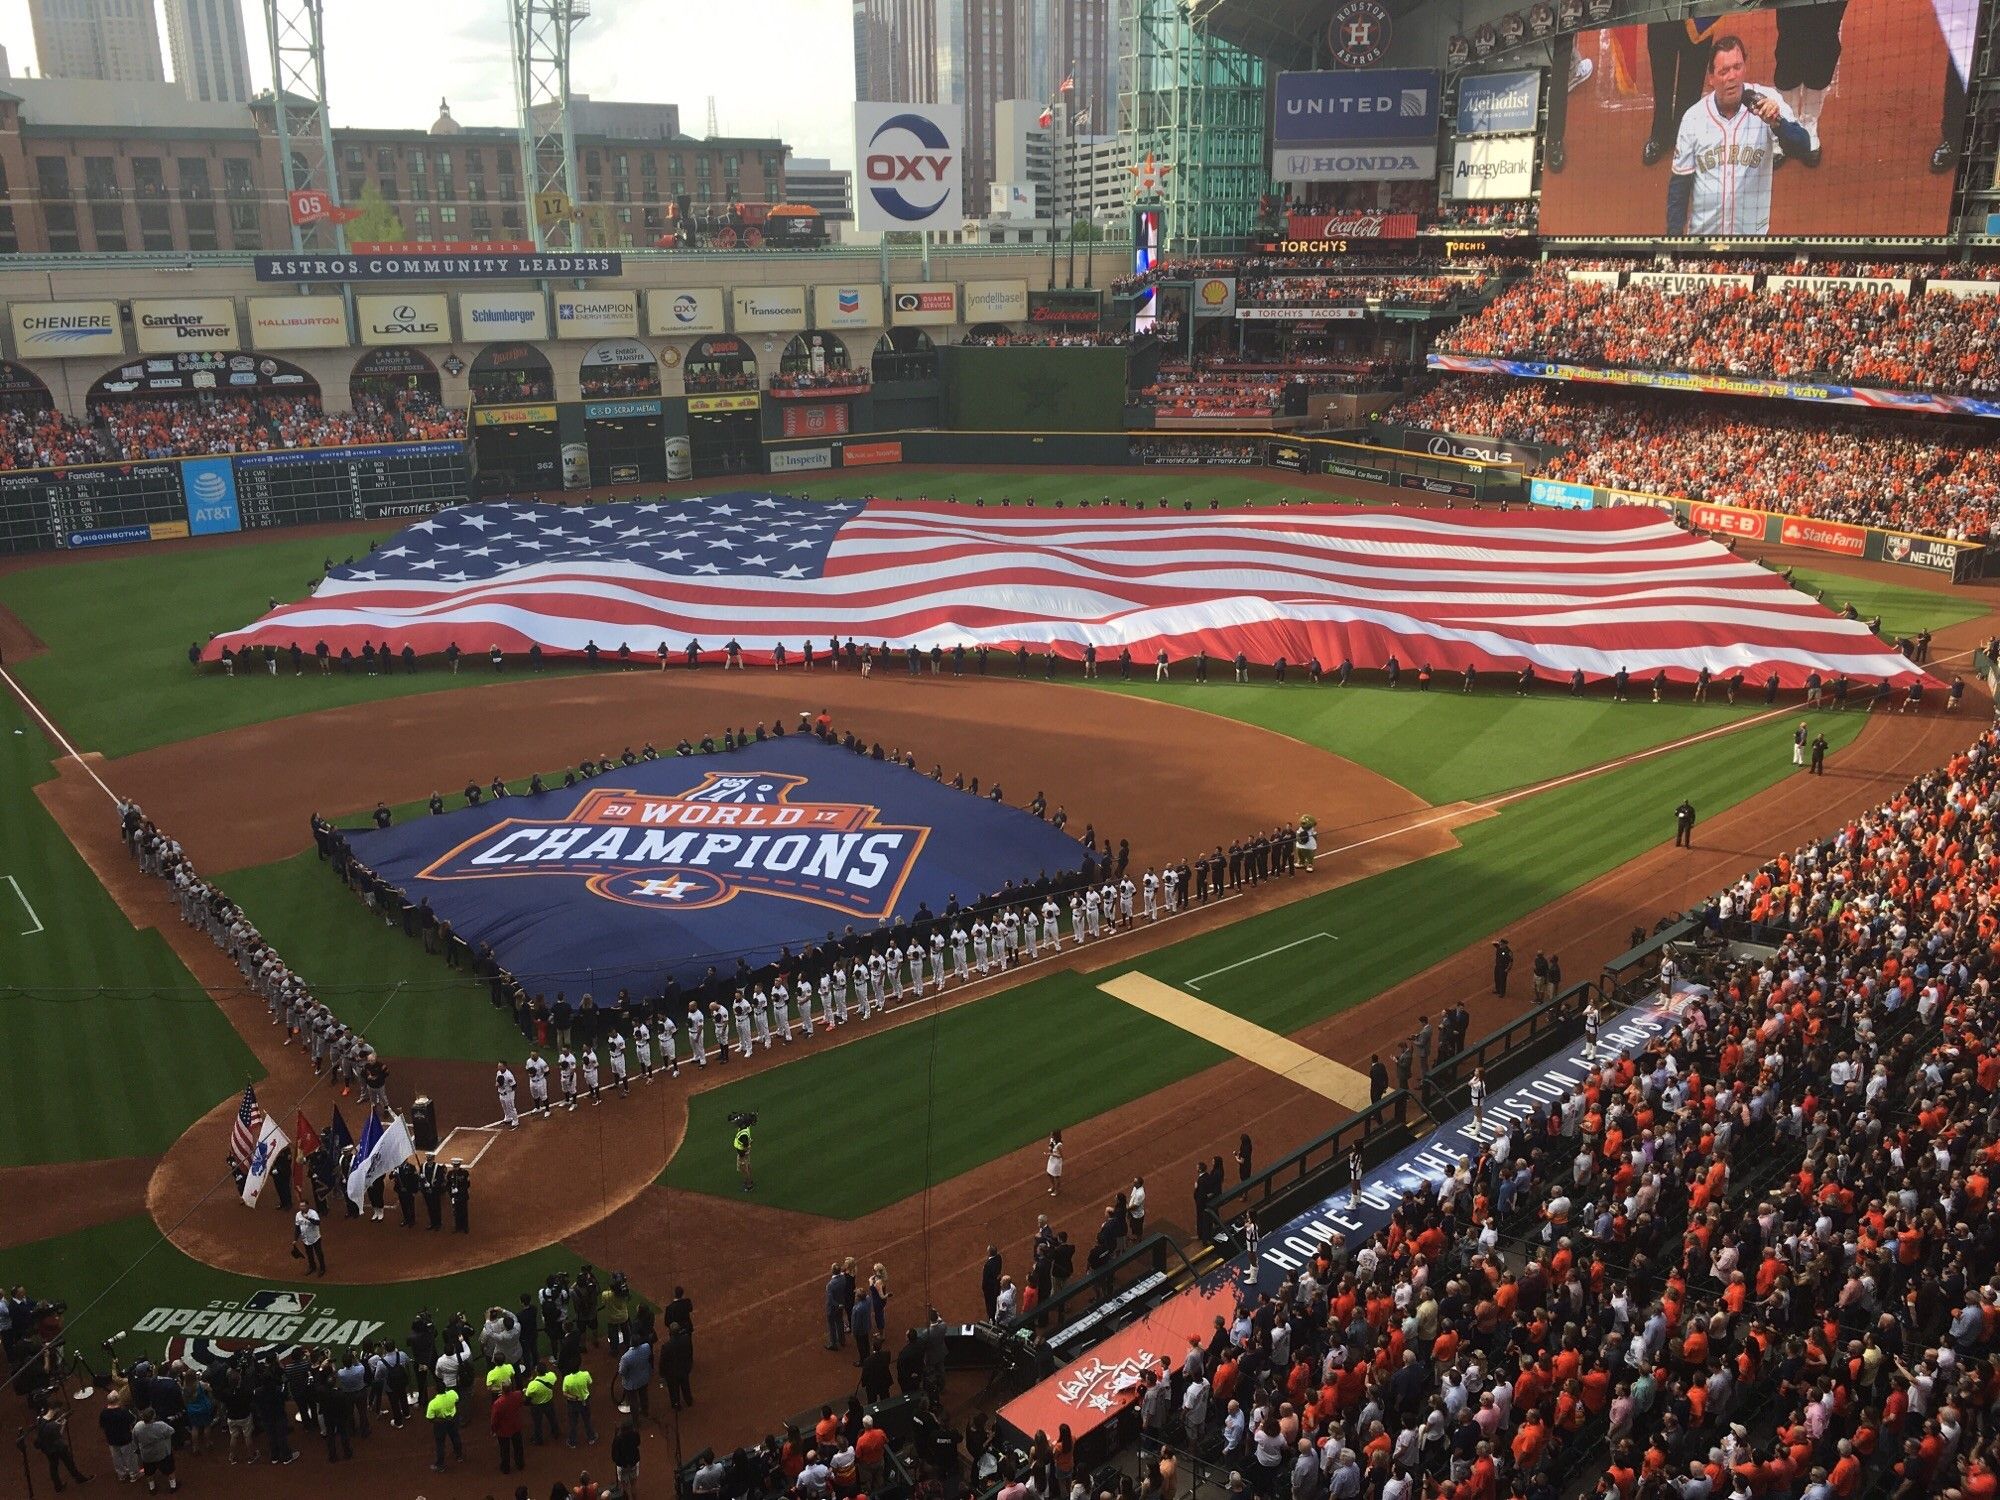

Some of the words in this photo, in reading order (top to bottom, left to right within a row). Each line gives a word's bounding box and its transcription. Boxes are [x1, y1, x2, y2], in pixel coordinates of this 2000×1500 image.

[1336, 2, 1385, 23] HOUSTON
[1337, 46, 1382, 66] ASTROS
[1286, 95, 1394, 115] UNITED
[1463, 91, 1530, 112] Methodist
[1312, 155, 1420, 173] HONDA
[1696, 144, 1765, 175] ASTROS
[866, 154, 953, 182] OXY
[1456, 158, 1528, 180] AmegyBank
[298, 197, 322, 215] 05
[543, 197, 562, 215] 17
[1323, 216, 1385, 238] Coca-Cola
[372, 244, 452, 252] MINUTE
[470, 244, 519, 252] MAID
[1280, 240, 1347, 253] TORCHYS
[270, 260, 360, 275] ASTROS
[369, 258, 509, 274] COMMUNITY
[519, 257, 610, 272] LEADERS
[574, 303, 633, 314] CHAMPION
[673, 305, 698, 313] OXY
[750, 306, 802, 316] Transocean
[1032, 306, 1101, 321] Budweiser
[1257, 309, 1305, 319] TORCHYS
[1310, 309, 1342, 318] TACOS
[22, 315, 112, 330] CHENIERE
[142, 313, 204, 327] Gardner
[257, 317, 340, 328] HALLIBURTON
[472, 309, 535, 324] Schlumberger
[177, 326, 231, 340] Denver
[372, 323, 439, 335] LEXUS
[615, 347, 638, 355] ENERGY
[616, 353, 645, 362] TRANSFER
[1545, 365, 1556, 376] O
[1557, 368, 1577, 381] say
[1577, 367, 1605, 381] does
[1605, 369, 1630, 383] that
[1718, 378, 1765, 394] Banner
[1769, 382, 1790, 398] yet
[1792, 385, 1829, 399] wave
[613, 405, 635, 415] SCRAP
[637, 404, 657, 413] METAL
[1191, 408, 1236, 420] Budweiser
[809, 417, 822, 427] 66
[274, 454, 305, 462] AIRLINES
[320, 450, 345, 458] UNITED
[786, 453, 828, 467] Insperity
[1451, 446, 1513, 464] LEXUS
[133, 464, 169, 476] Fanatics
[536, 462, 554, 470] 362
[1334, 465, 1357, 477] National
[1468, 465, 1482, 473] 373
[1, 475, 39, 486] Fanatics
[68, 469, 105, 480] Fanatics
[195, 506, 232, 525] AT&T
[82, 530, 147, 542] HIGGINBOTHAM
[1929, 542, 1956, 557] MLB
[603, 803, 633, 817] 20
[638, 802, 805, 827] WORLD
[812, 809, 838, 823] 17
[470, 827, 903, 889] CHAMPIONS
[1262, 1208, 1363, 1272] HOME
[1360, 1178, 1405, 1211] OF
[1397, 1141, 1469, 1186] THE
[1456, 1070, 1582, 1144] HOUSTON
[132, 1306, 306, 1343] OPENING
[298, 1317, 386, 1347] DAY
